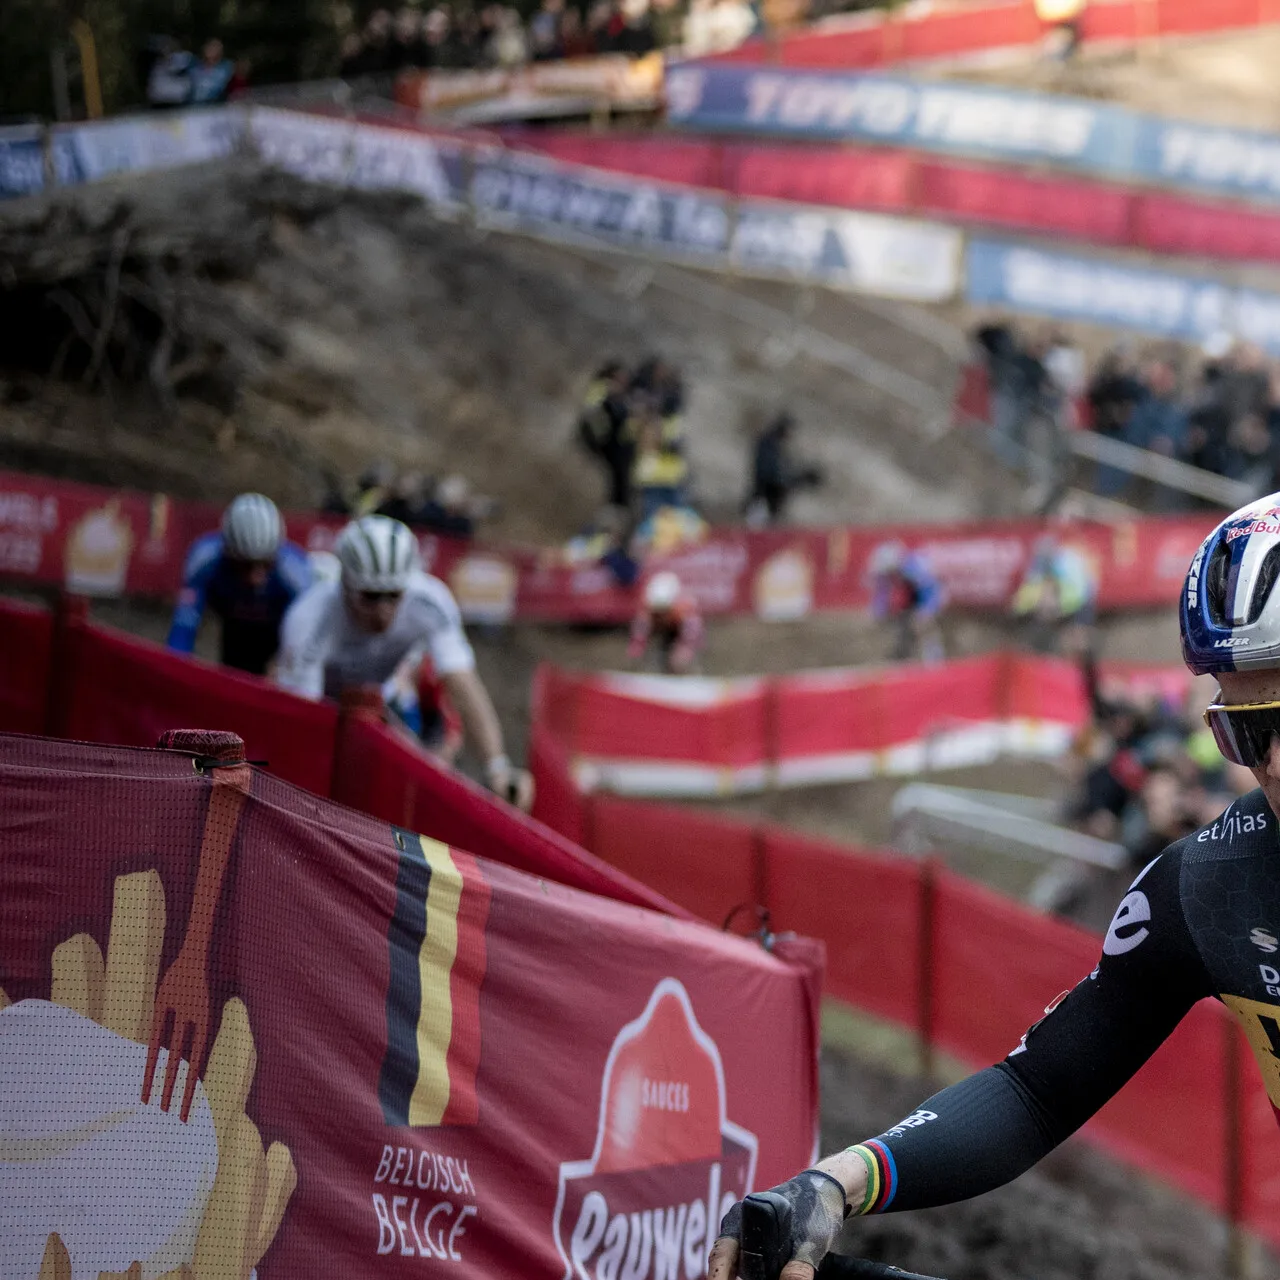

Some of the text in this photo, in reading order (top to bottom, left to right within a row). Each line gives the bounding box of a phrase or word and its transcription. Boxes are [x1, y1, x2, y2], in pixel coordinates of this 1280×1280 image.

[1214, 637, 1250, 648] LAZER
[1198, 802, 1267, 844] ethias
[641, 1078, 690, 1112] SAUCES
[374, 1144, 476, 1196] BELGISCH
[372, 1192, 478, 1261] BELGE
